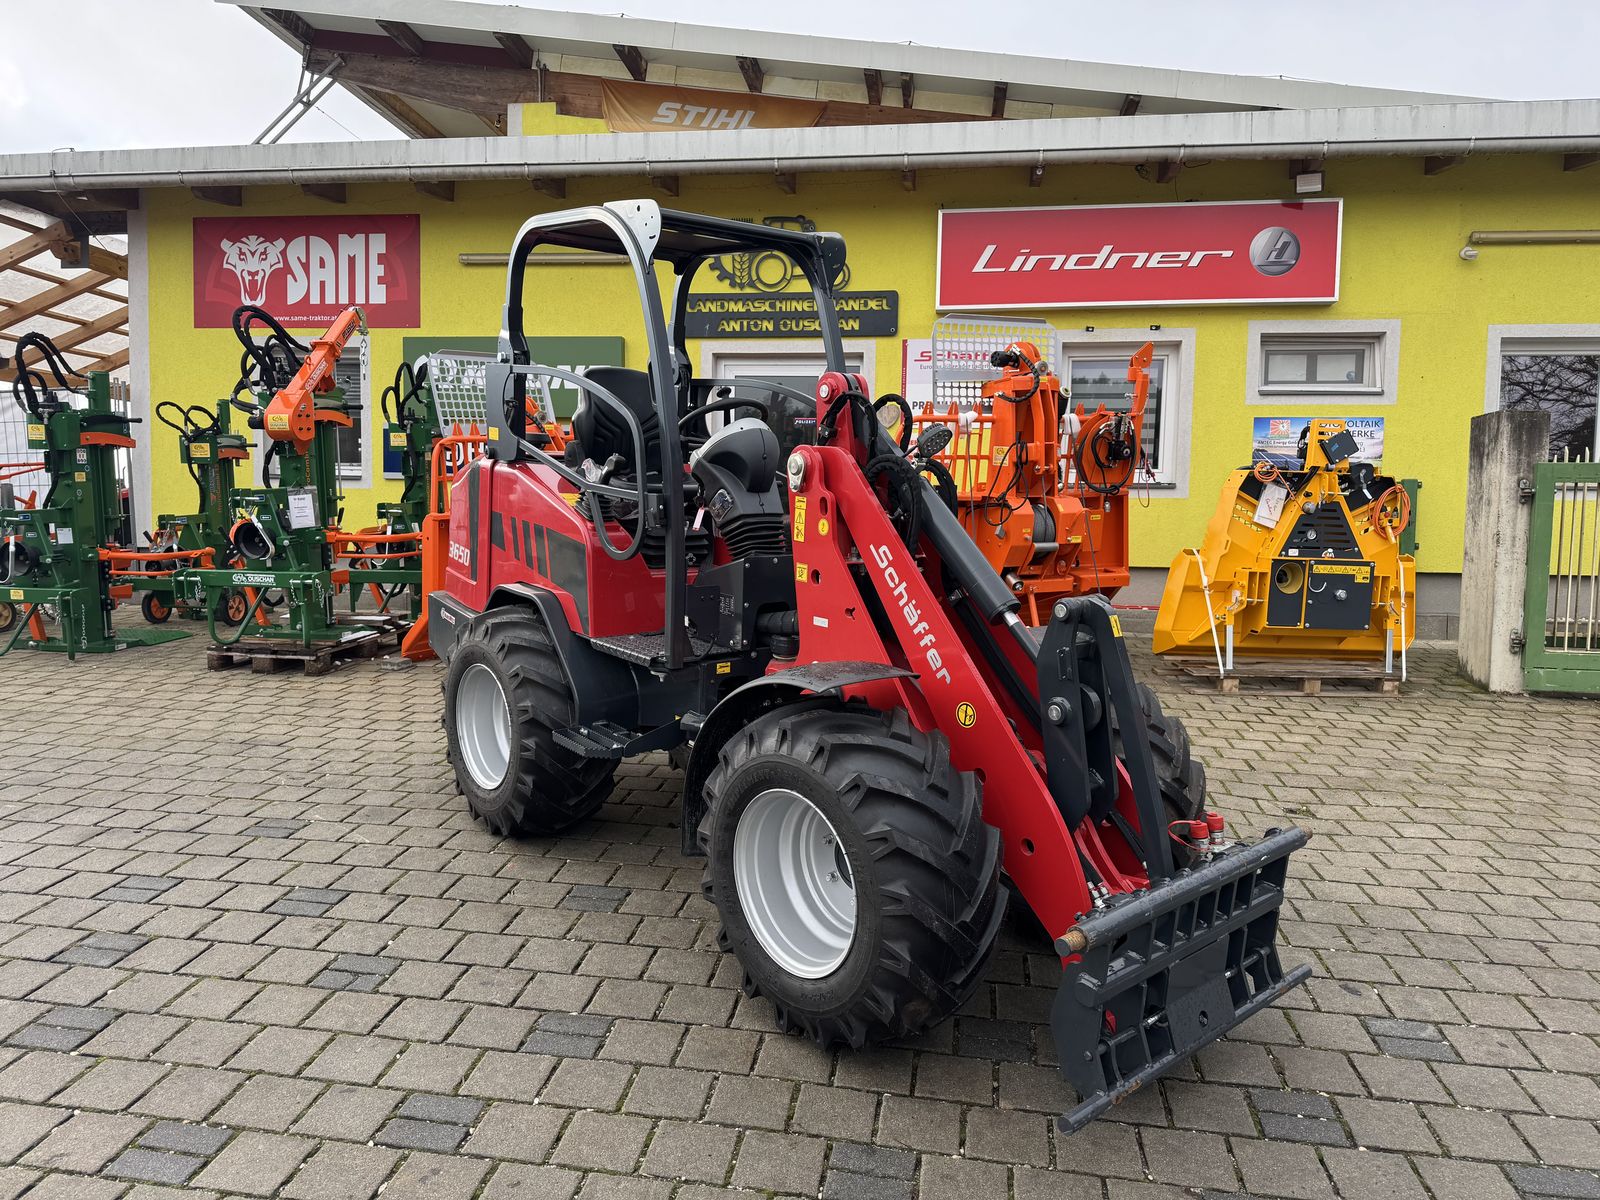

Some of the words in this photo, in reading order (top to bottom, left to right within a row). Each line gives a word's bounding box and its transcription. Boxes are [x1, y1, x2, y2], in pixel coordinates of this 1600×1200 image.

[652, 101, 758, 130] STIHL
[286, 233, 387, 306] SAME
[971, 244, 1234, 273] Lindner
[686, 297, 892, 313] LANDMASCHINEANDEL
[717, 318, 774, 332] ANTON
[779, 318, 860, 331] OUSCAN
[448, 541, 471, 567] 3650
[869, 543, 952, 686] Schäffer
